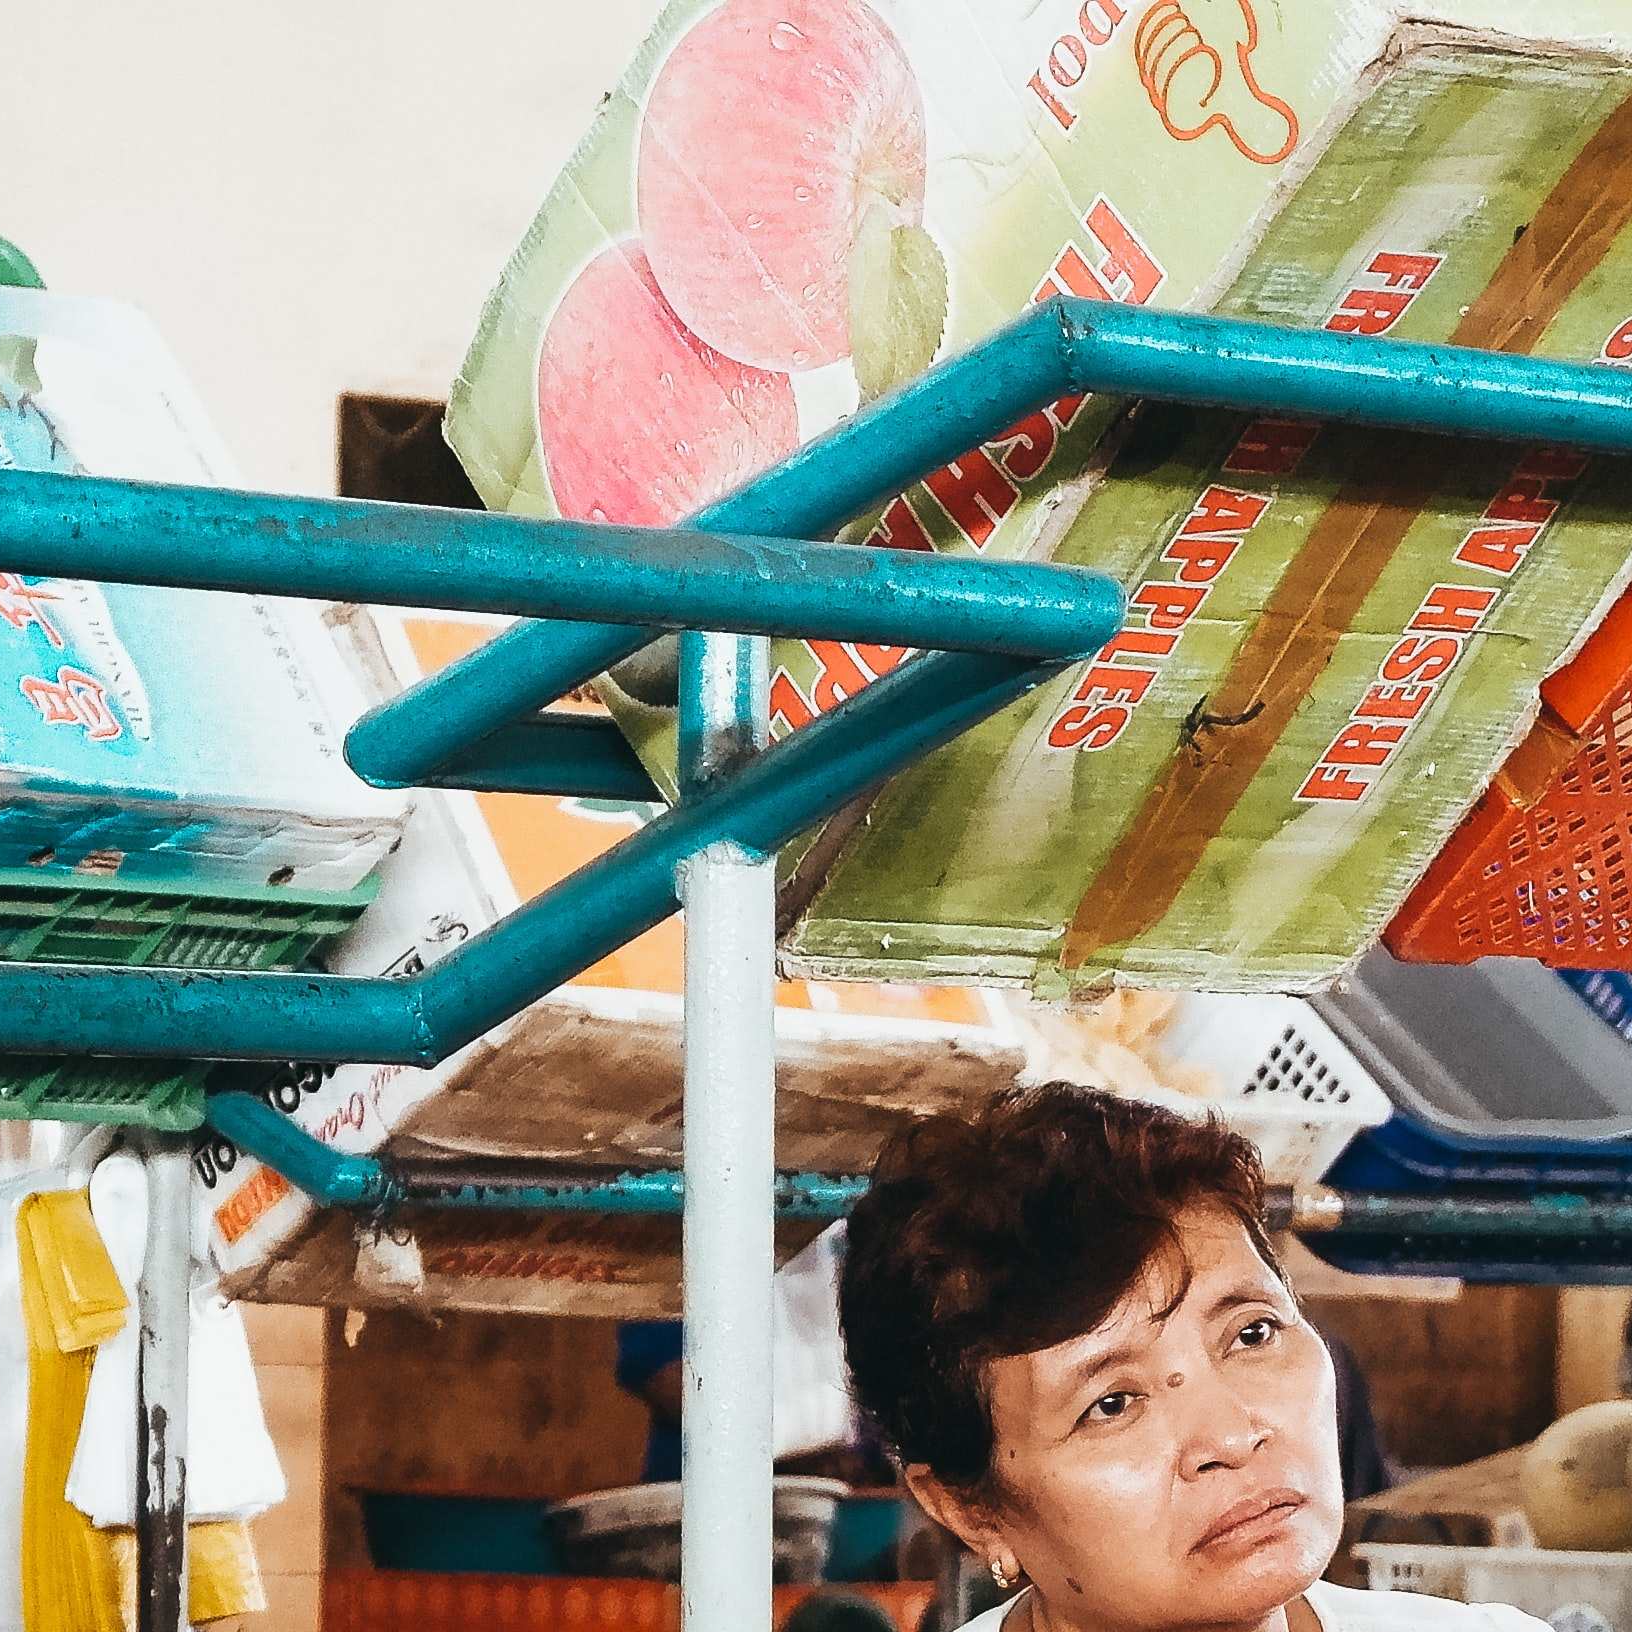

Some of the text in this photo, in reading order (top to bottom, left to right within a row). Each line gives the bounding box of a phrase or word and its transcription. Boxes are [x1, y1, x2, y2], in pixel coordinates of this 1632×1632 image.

[1048, 250, 1447, 752] FRH APPLES
[1294, 584, 1501, 801] FRESH
